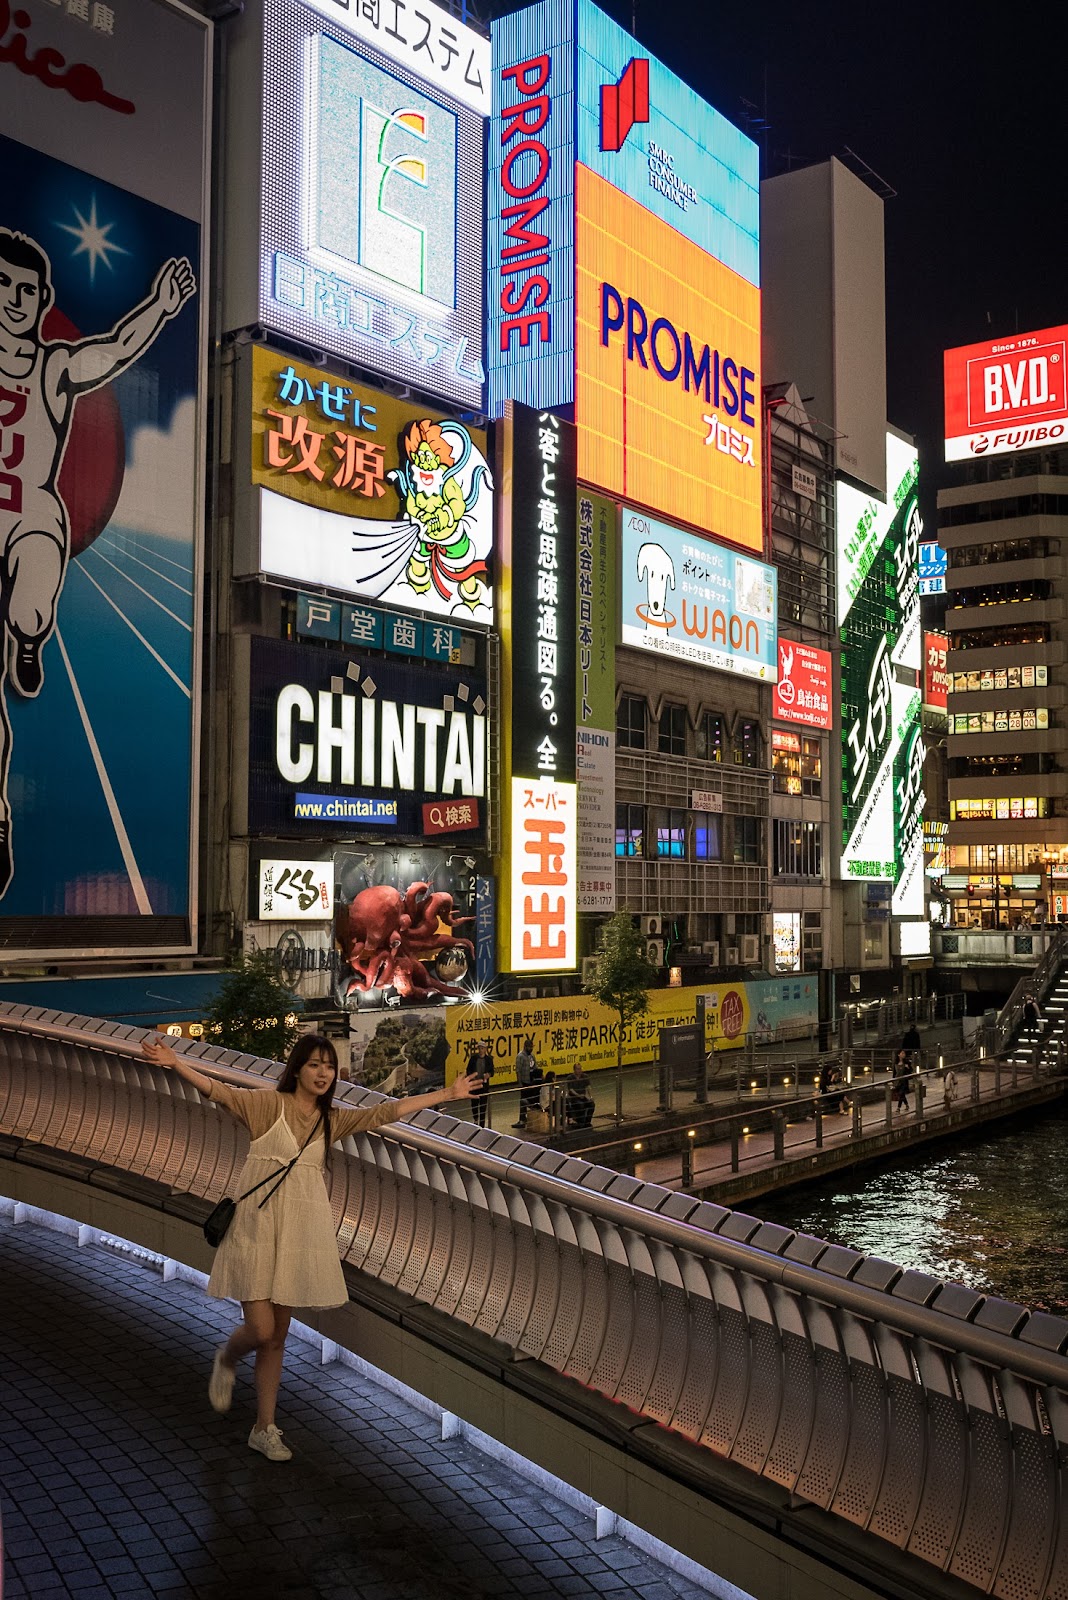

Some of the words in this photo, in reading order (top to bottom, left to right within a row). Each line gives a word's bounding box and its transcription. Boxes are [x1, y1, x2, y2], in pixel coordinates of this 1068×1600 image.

[331, 0, 484, 95] 商エステム
[649, 140, 675, 171] SMBC
[500, 53, 551, 353] PROMISE
[648, 157, 698, 205] CONSUMER
[649, 172, 688, 212] FINANCE
[275, 252, 485, 385] 日商エステム
[600, 281, 755, 428] PROMISE
[992, 343, 1015, 353] Since
[279, 365, 378, 431] かぜに
[984, 356, 1056, 413] B.V.D.
[264, 407, 387, 498] 改源
[702, 413, 756, 467] プロミス
[993, 424, 1065, 449] FUJIBO
[306, 599, 454, 656] 戸堂歯科
[578, 497, 593, 722] 株式会社日本リート
[681, 598, 759, 654] WAON
[450, 650, 461, 663] 3F
[848, 652, 897, 776] エイブル
[276, 683, 485, 797] CHINTAI
[577, 731, 609, 748] NIHON
[577, 744, 592, 756] Real
[577, 756, 596, 769] Estate
[445, 805, 472, 826] 検索
[523, 788, 567, 811] スーパー
[274, 868, 320, 911] くくる
[521, 818, 568, 960] 玉出
[577, 895, 612, 906] 6-6281-1717
[456, 1008, 590, 1033] 从这里到大阪最大级别的购物中心
[723, 995, 740, 1018] TAX
